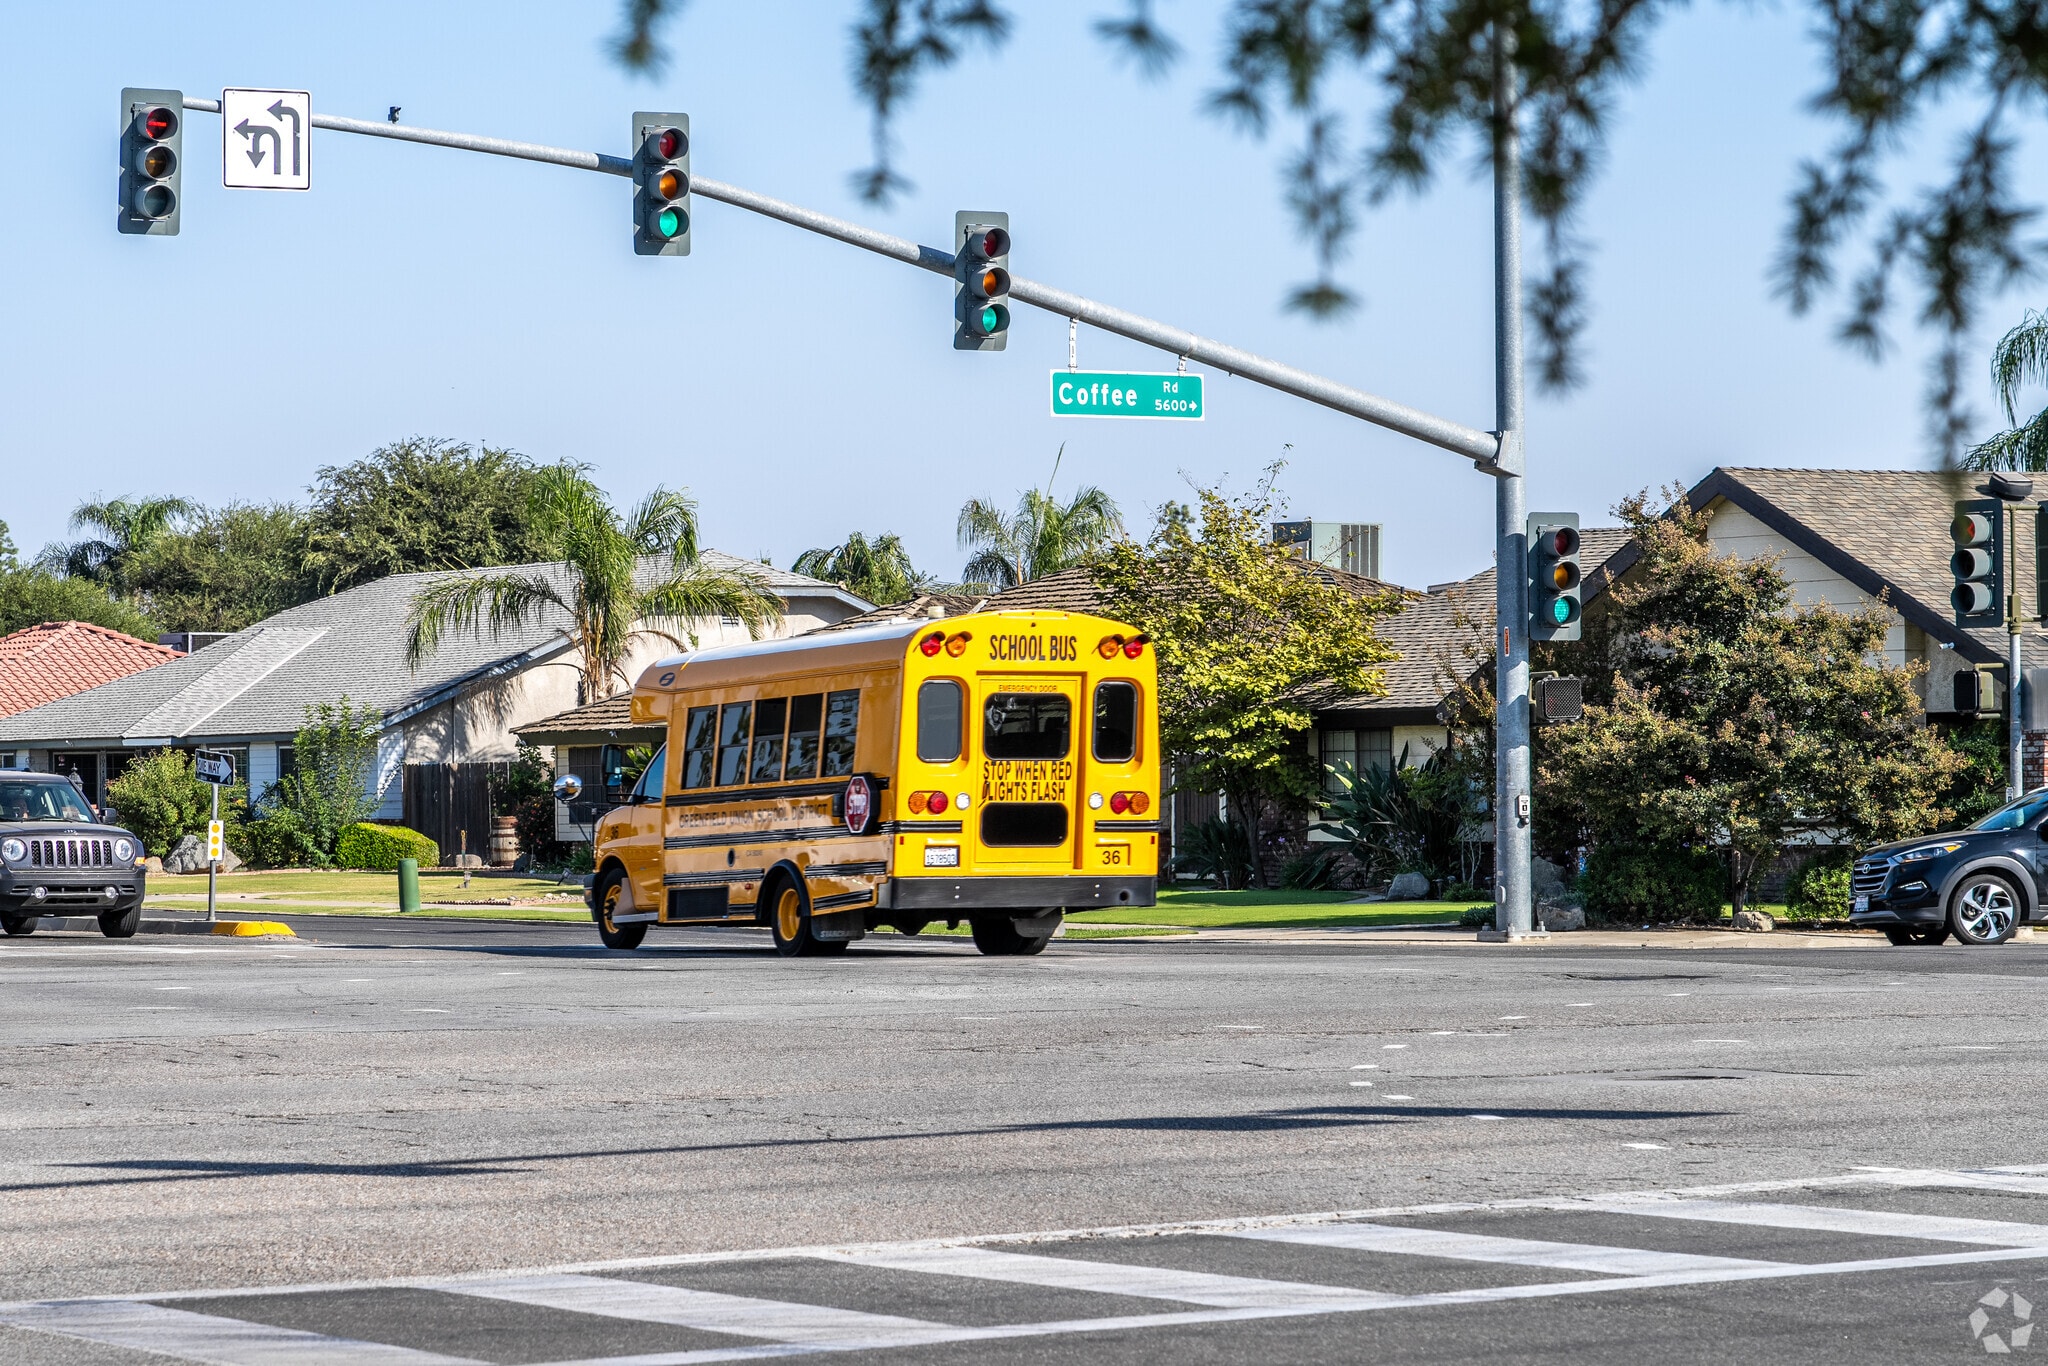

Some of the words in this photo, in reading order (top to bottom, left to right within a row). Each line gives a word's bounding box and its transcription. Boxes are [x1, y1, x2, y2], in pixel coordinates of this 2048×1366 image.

[1058, 382, 1138, 407] Coffee
[1162, 381, 1179, 393] Rd
[1154, 399, 1188, 412] 5600
[989, 634, 1046, 661] SCHOOL
[1049, 635, 1077, 661] BUS
[207, 761, 221, 775] WAY
[983, 760, 1011, 781] STOP
[1015, 760, 1047, 781] WHEN
[1051, 761, 1072, 781] RED
[987, 782, 1028, 801] LIGHTS
[1031, 782, 1066, 801] FLASH
[757, 806, 789, 823] SCHOOL
[791, 803, 828, 821] DISTRICT
[1102, 850, 1121, 865] 36
